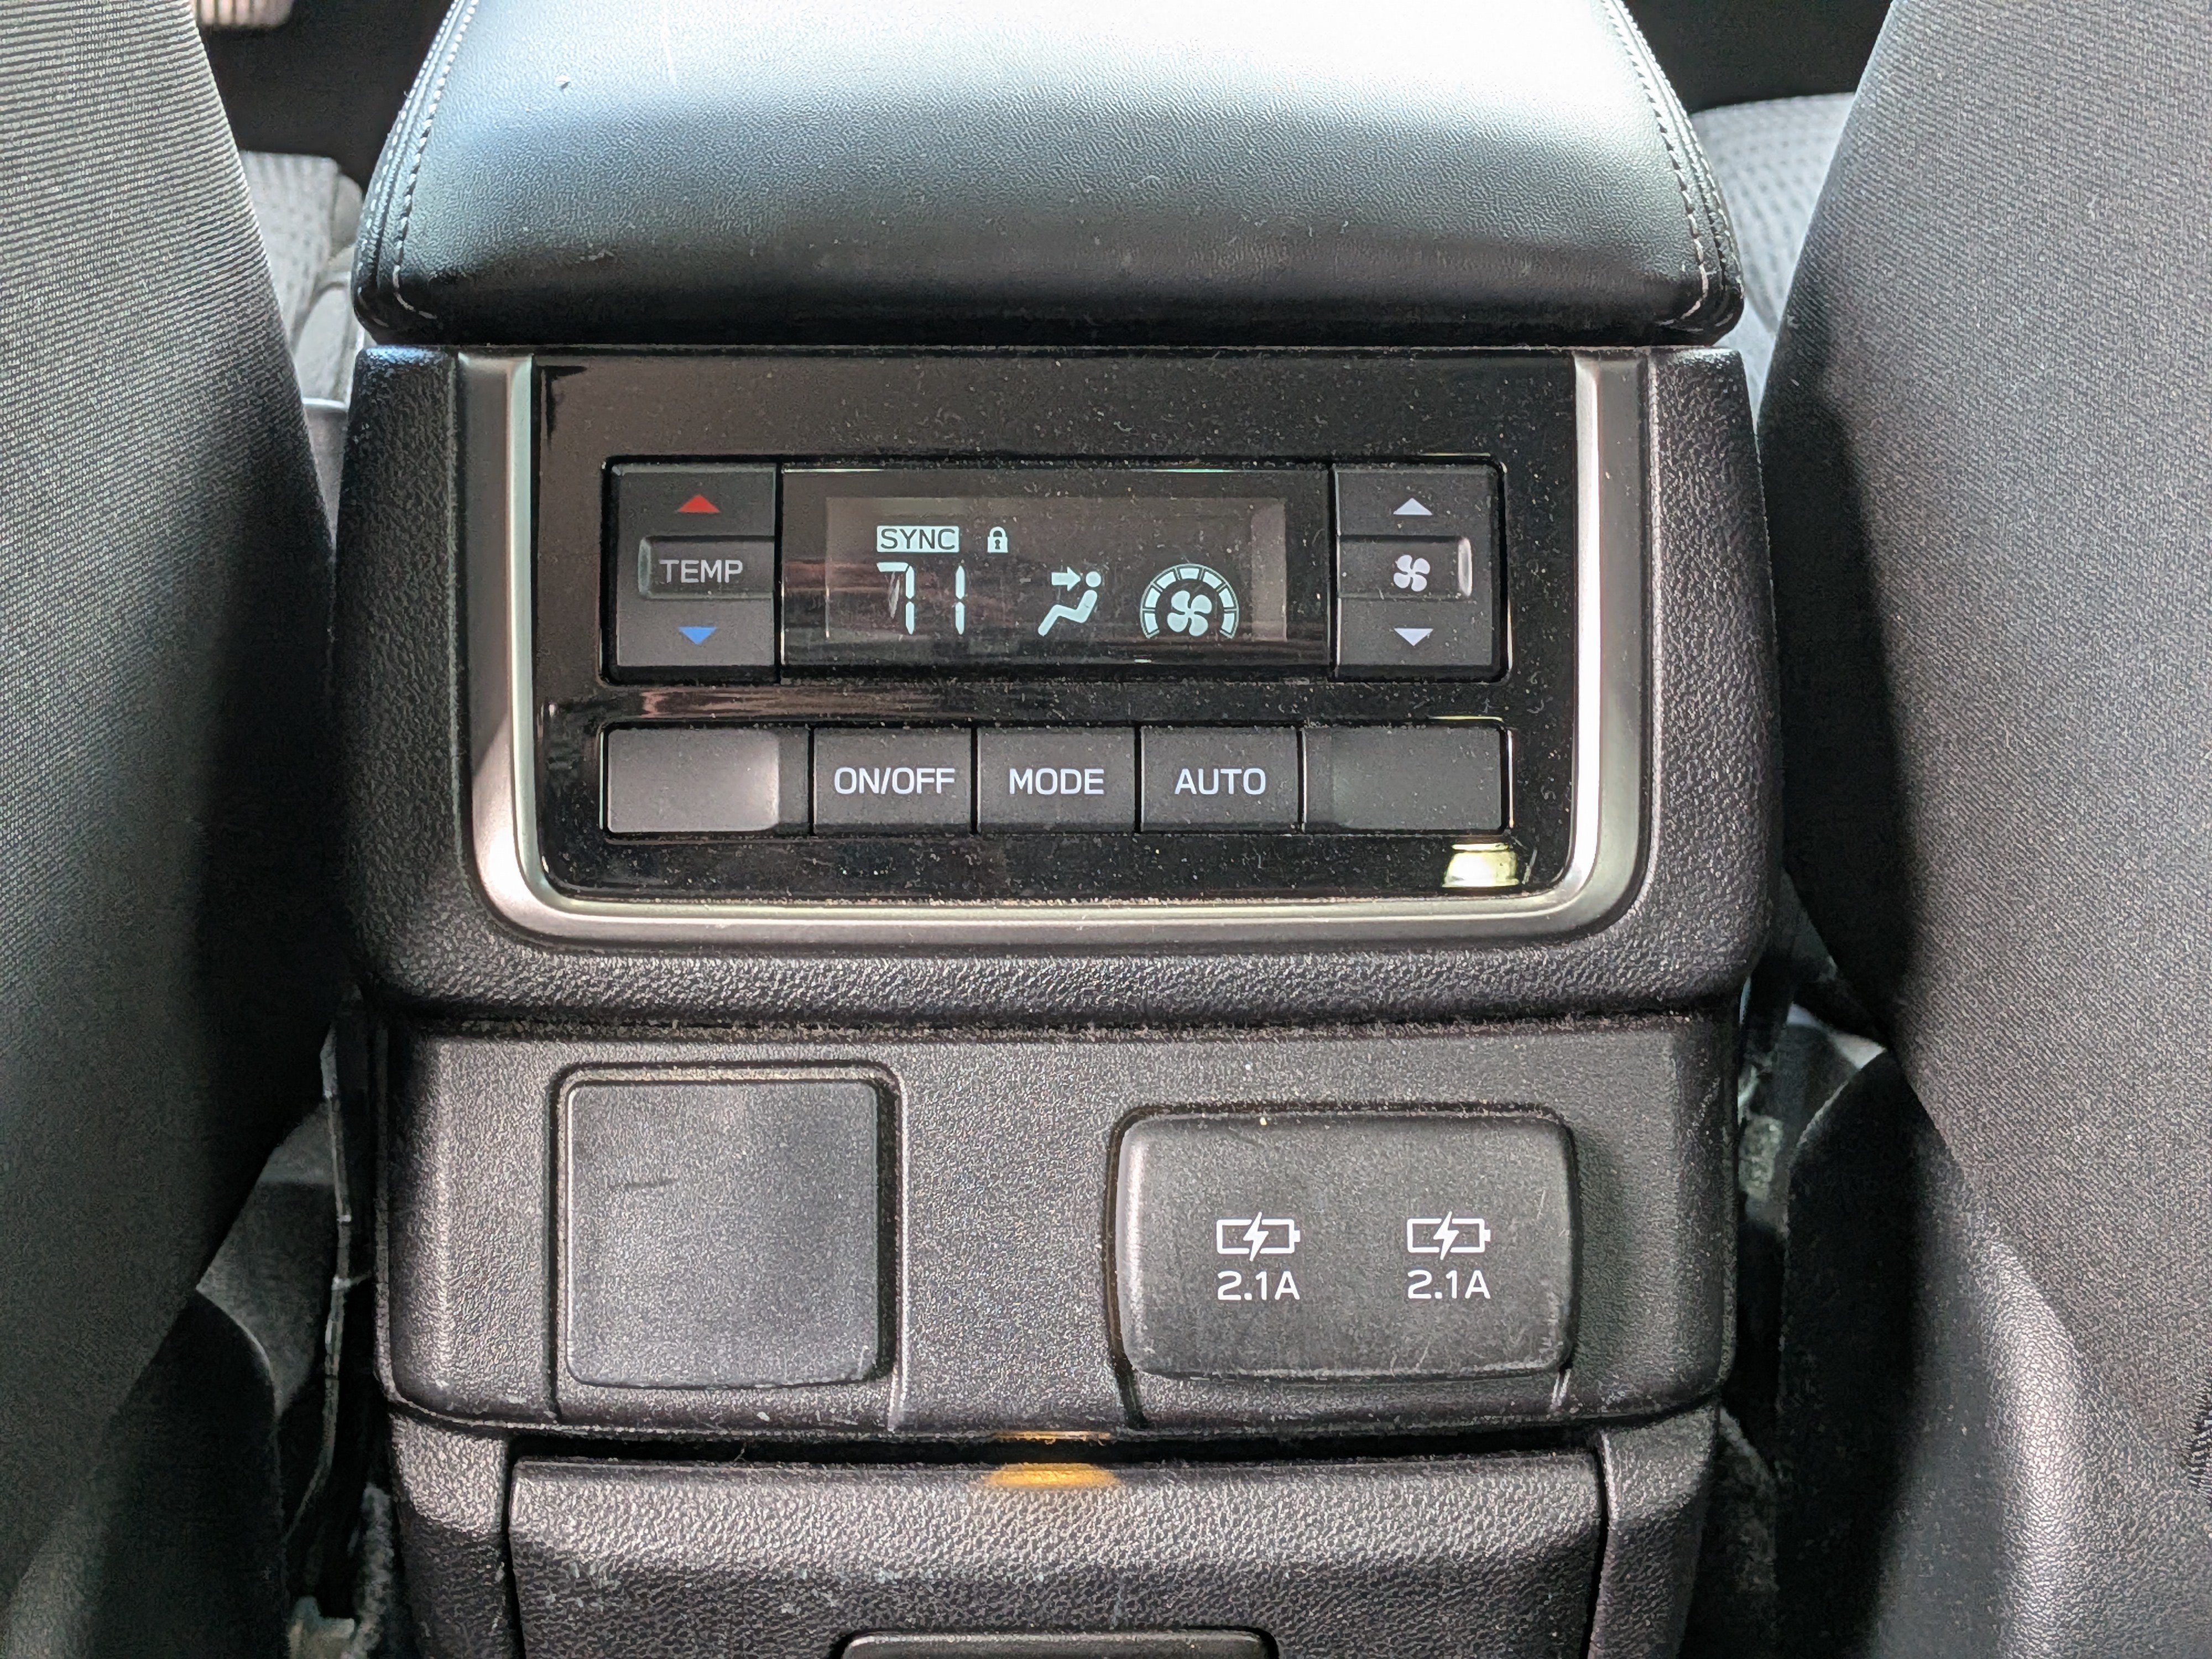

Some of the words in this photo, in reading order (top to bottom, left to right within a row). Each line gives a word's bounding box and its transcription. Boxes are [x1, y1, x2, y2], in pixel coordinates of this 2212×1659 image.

[878, 527, 958, 551] SYNC
[660, 559, 744, 583] TEMP
[876, 561, 964, 635] 71
[833, 767, 956, 795] ON/OFF
[1008, 766, 1105, 795] MODE
[1174, 767, 1267, 795] AUTO
[1217, 1270, 1300, 1300] 2.1A
[1407, 1270, 1490, 1299] 2.1A
